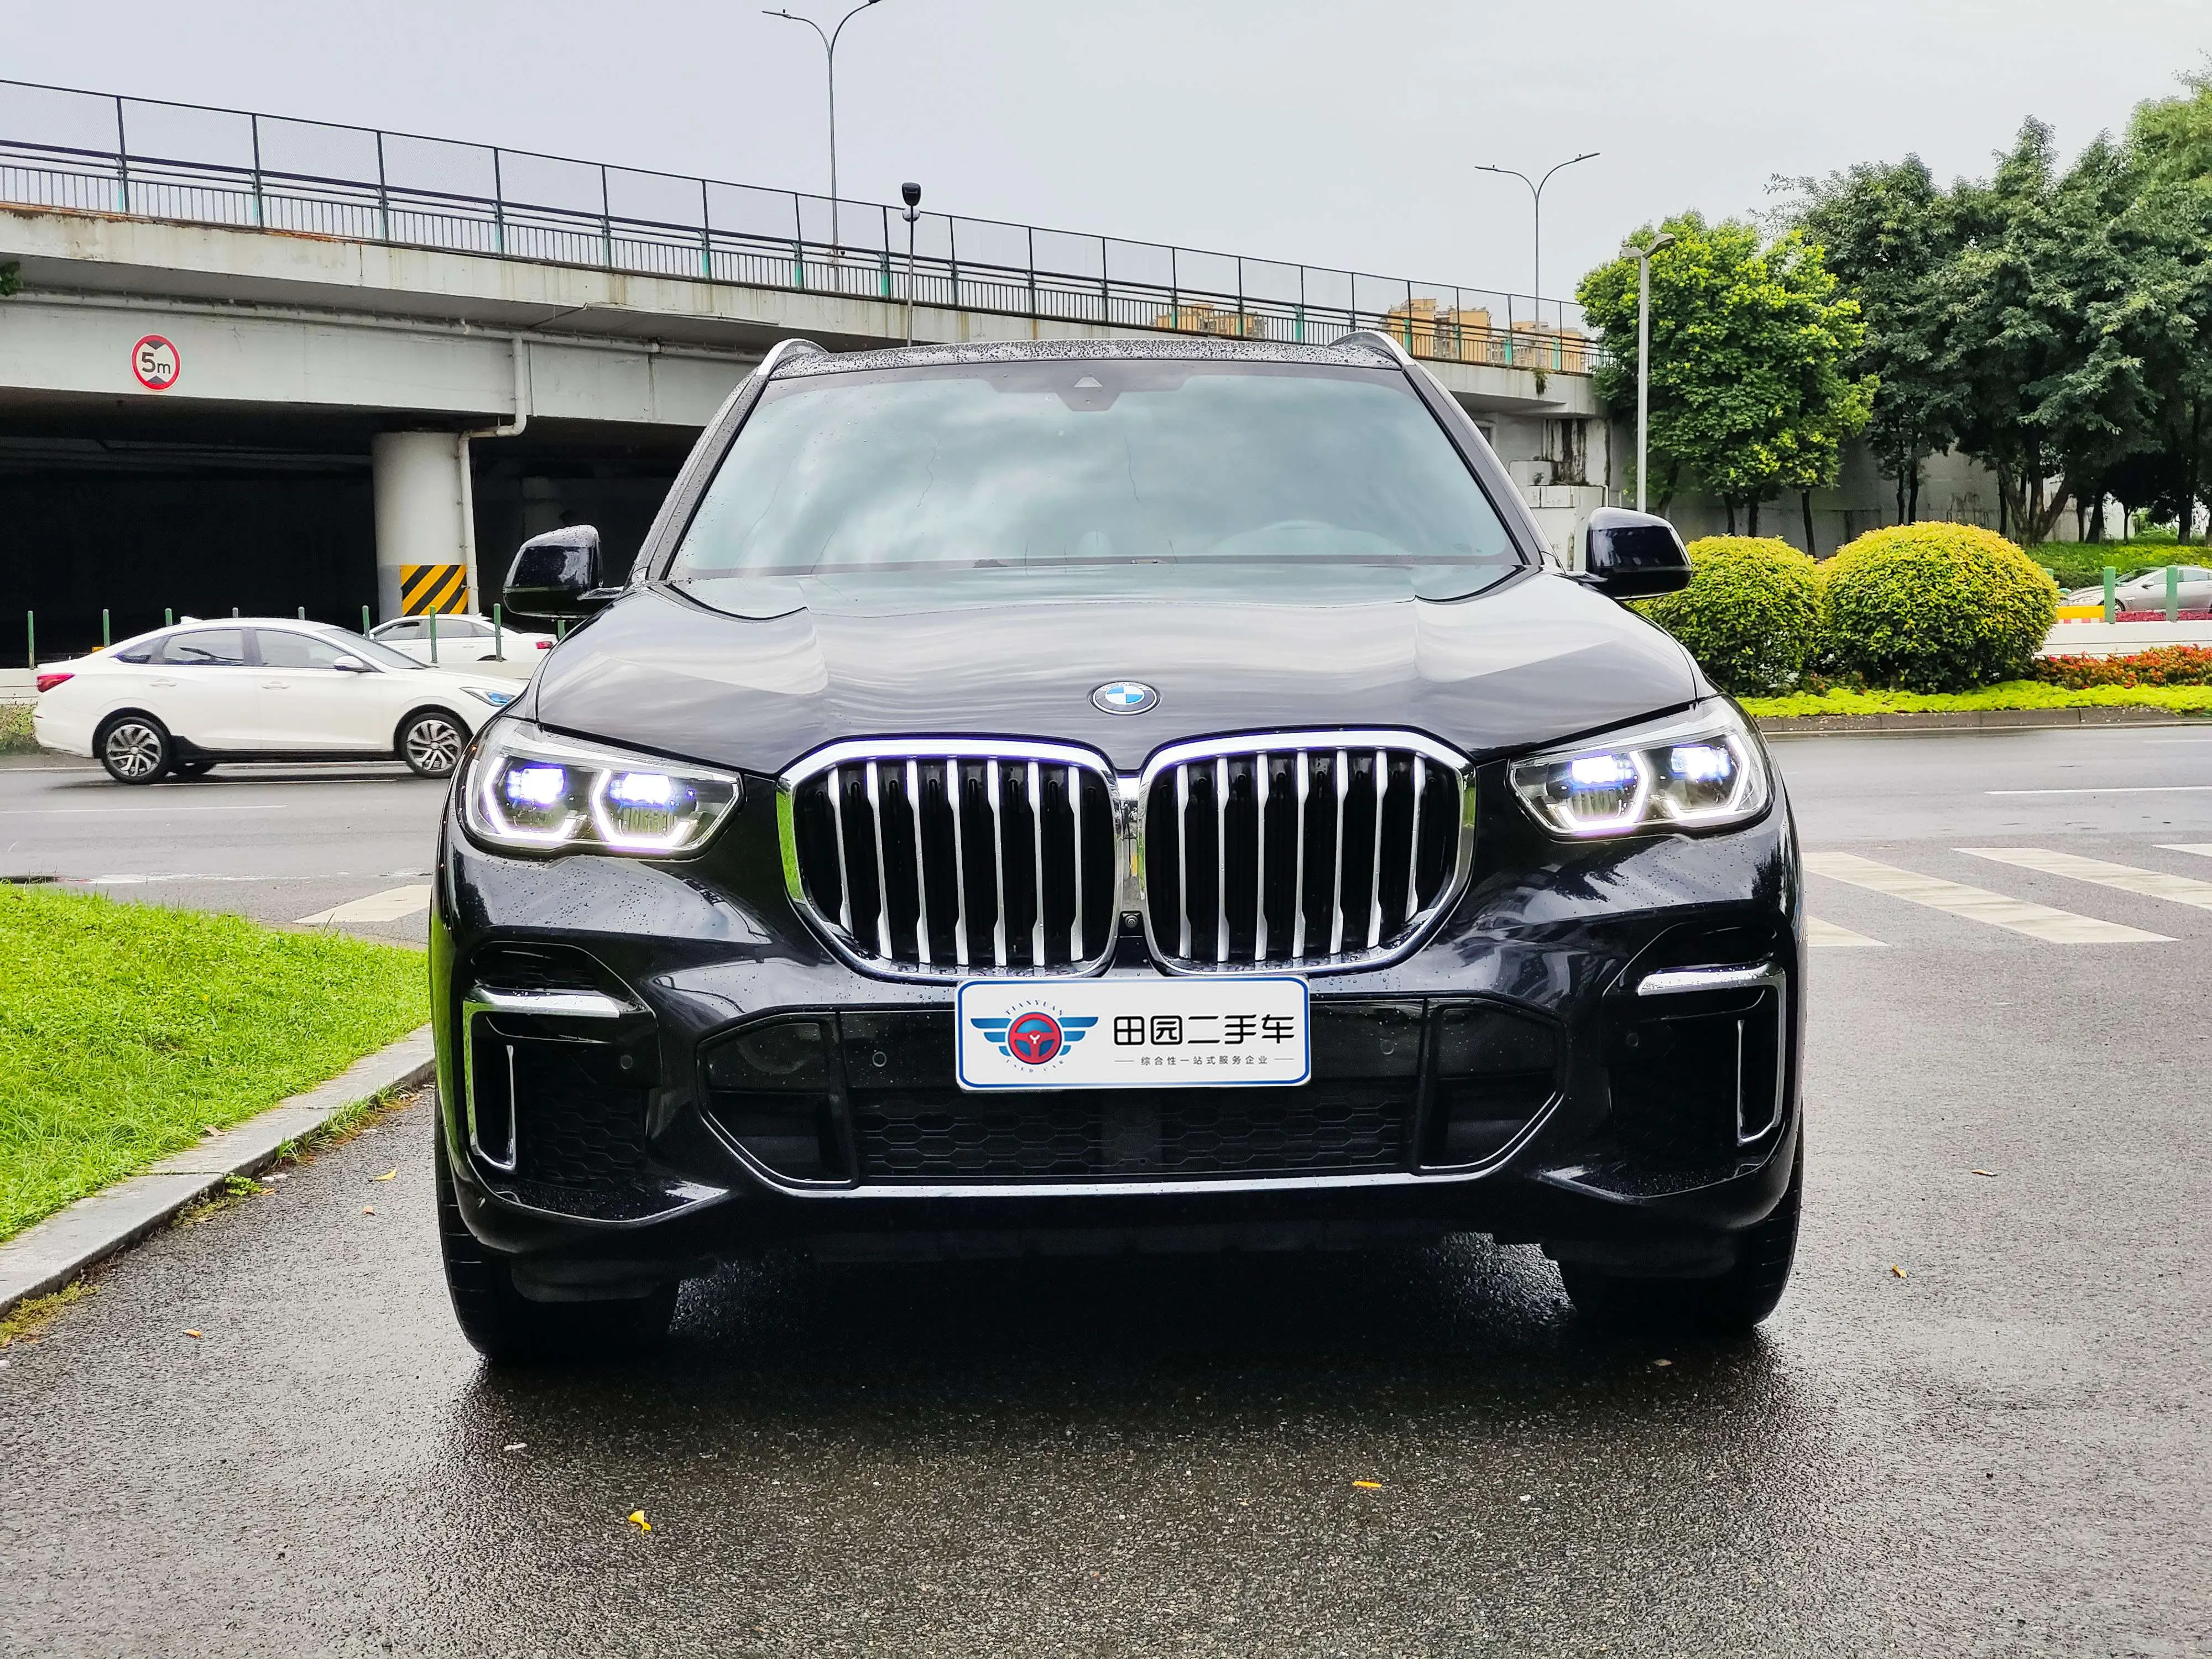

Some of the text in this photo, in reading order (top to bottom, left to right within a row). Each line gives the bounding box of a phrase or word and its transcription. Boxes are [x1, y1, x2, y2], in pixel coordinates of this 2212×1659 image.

[142, 352, 171, 374] 5m
[1113, 1014, 1295, 1045] 田园二手车
[1140, 1055, 1267, 1066] 综合性一站式服务企业
